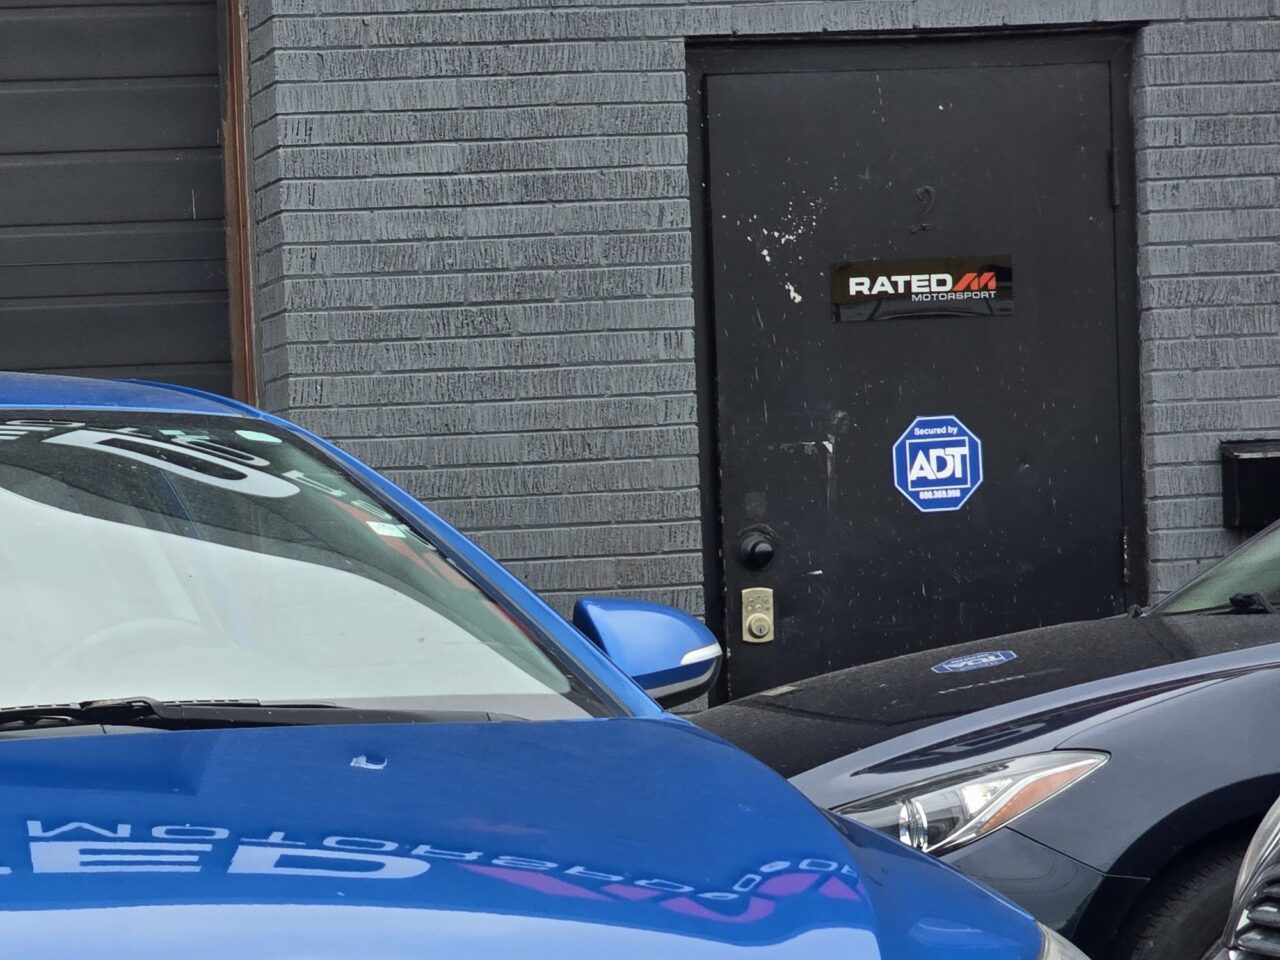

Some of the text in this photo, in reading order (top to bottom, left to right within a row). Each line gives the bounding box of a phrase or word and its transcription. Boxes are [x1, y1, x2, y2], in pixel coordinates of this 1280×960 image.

[849, 273, 953, 295] RATED
[911, 291, 997, 302] MOTORSPORT
[914, 426, 958, 435] Secured by
[908, 447, 968, 480] ADT
